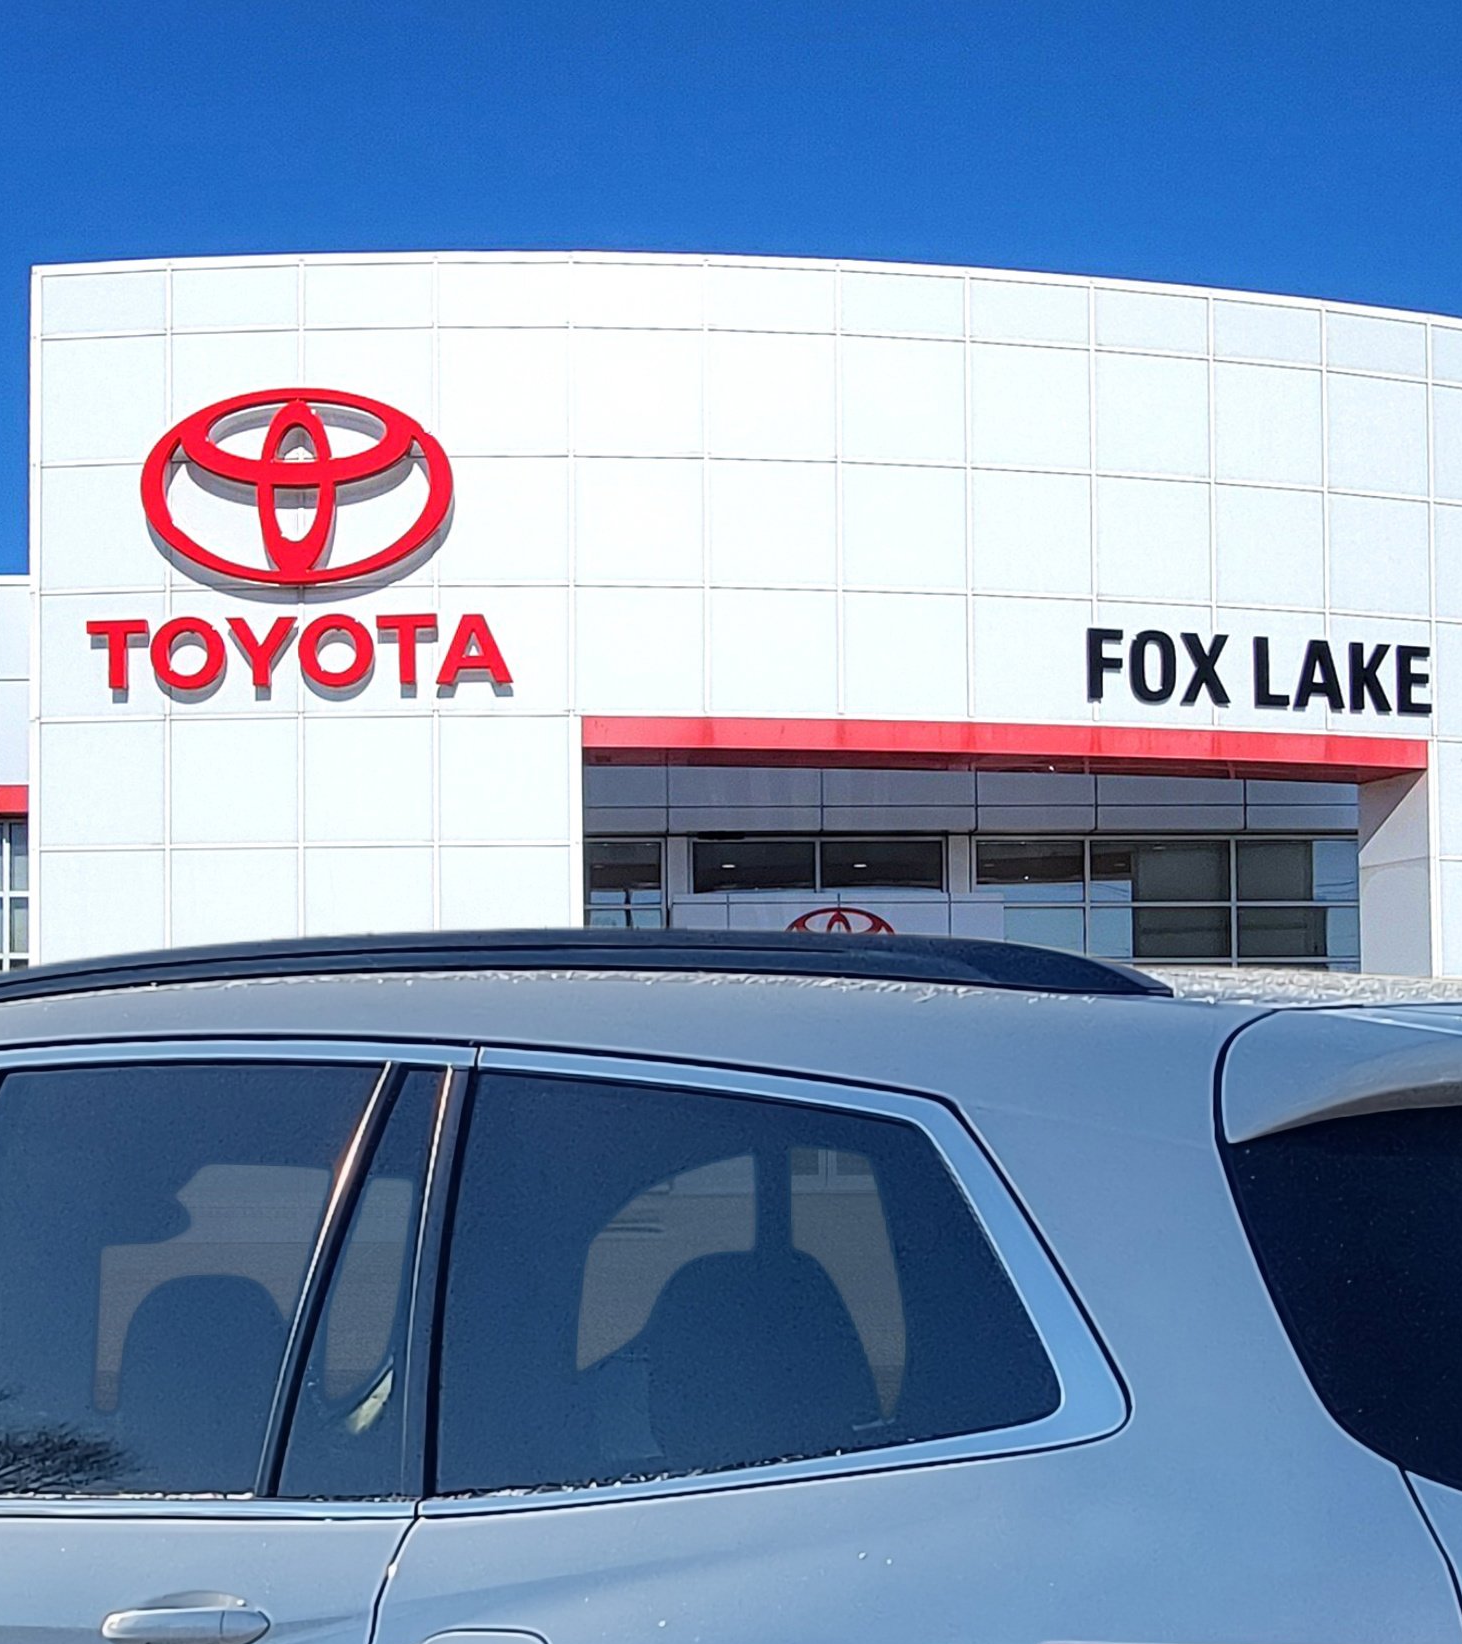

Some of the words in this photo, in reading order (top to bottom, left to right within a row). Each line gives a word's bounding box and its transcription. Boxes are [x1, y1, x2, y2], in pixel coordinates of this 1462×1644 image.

[86, 613, 514, 692] TOYOTA
[1086, 627, 1231, 706] FOX
[1253, 636, 1433, 716] LAKE
